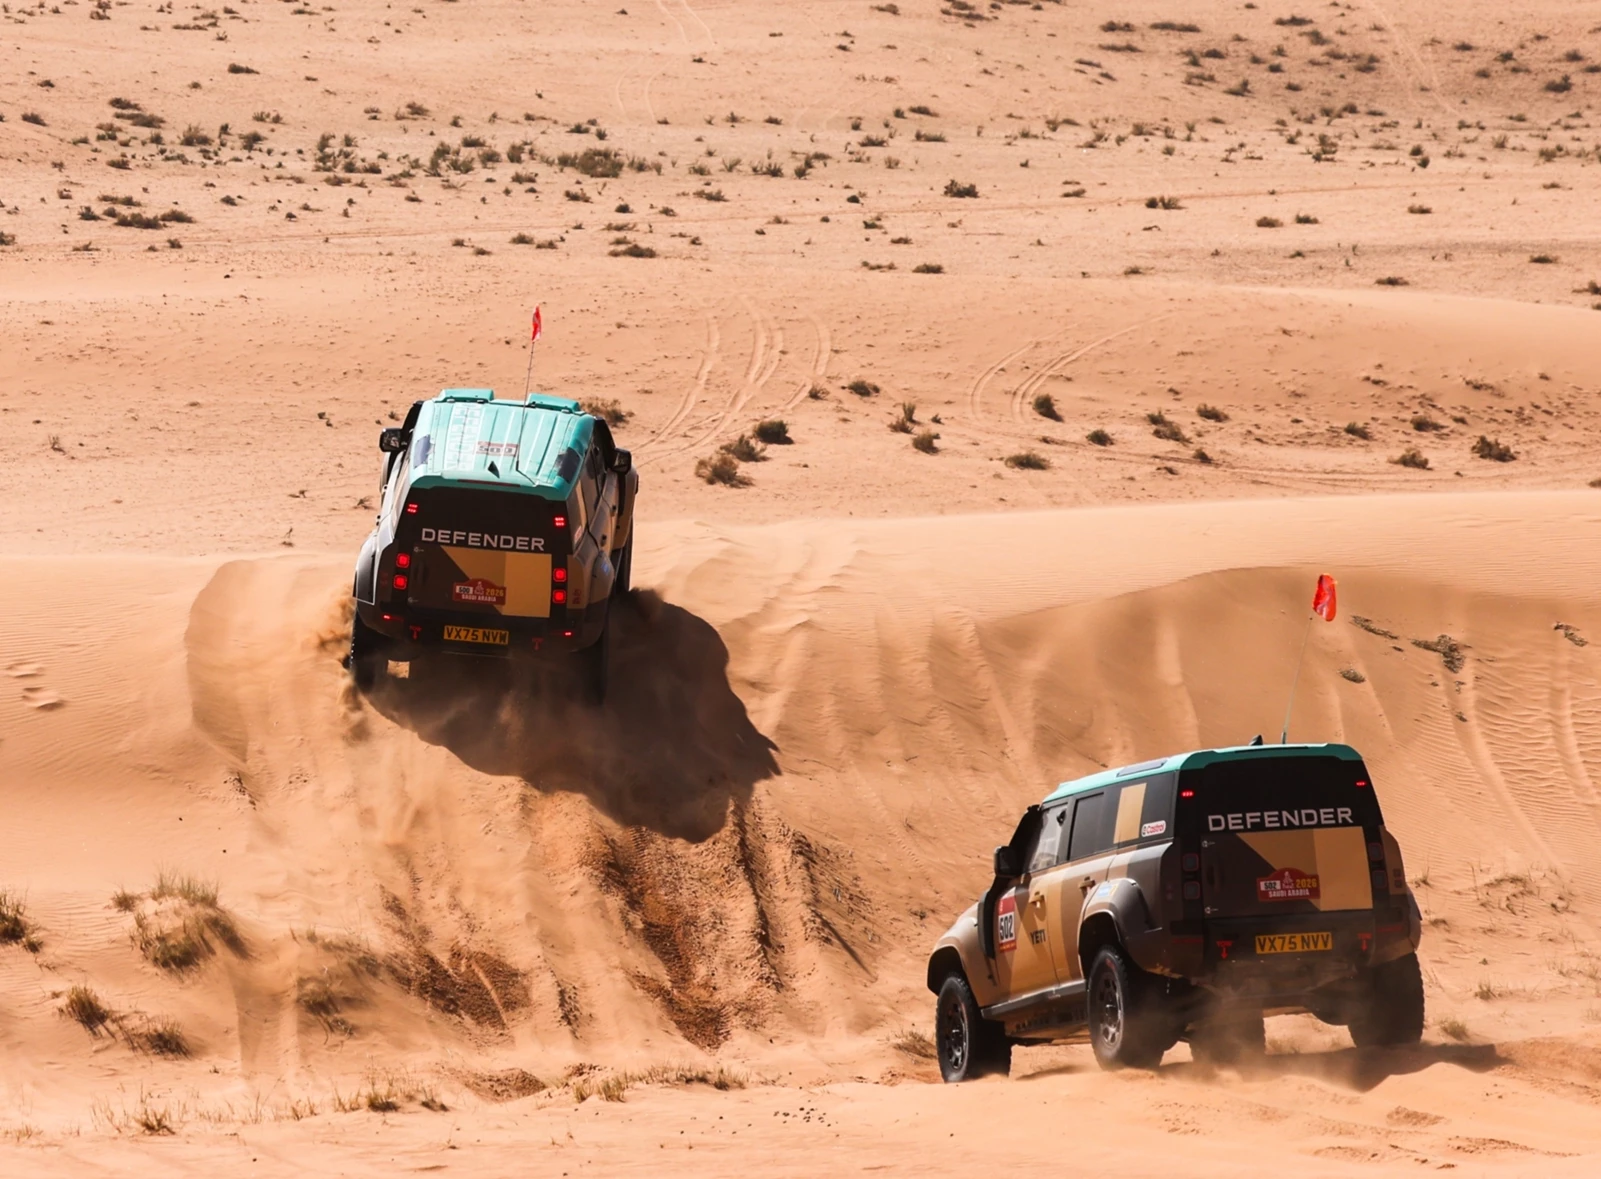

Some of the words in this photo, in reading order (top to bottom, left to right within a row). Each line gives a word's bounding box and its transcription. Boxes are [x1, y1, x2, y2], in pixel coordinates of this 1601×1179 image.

[421, 528, 545, 551] DEFENDER
[458, 586, 471, 594] 500
[486, 588, 504, 597] 2026
[446, 627, 479, 641] VX75
[1208, 807, 1354, 832] DEFENDER
[1264, 881, 1277, 890] 502
[1296, 878, 1317, 888] 2026
[1268, 890, 1287, 898] SAUDI
[1287, 888, 1310, 897] ARABIA
[999, 914, 1014, 940] 502
[1030, 929, 1046, 945] YETI
[1257, 935, 1298, 952] VX75
[1301, 933, 1330, 950] NVV
